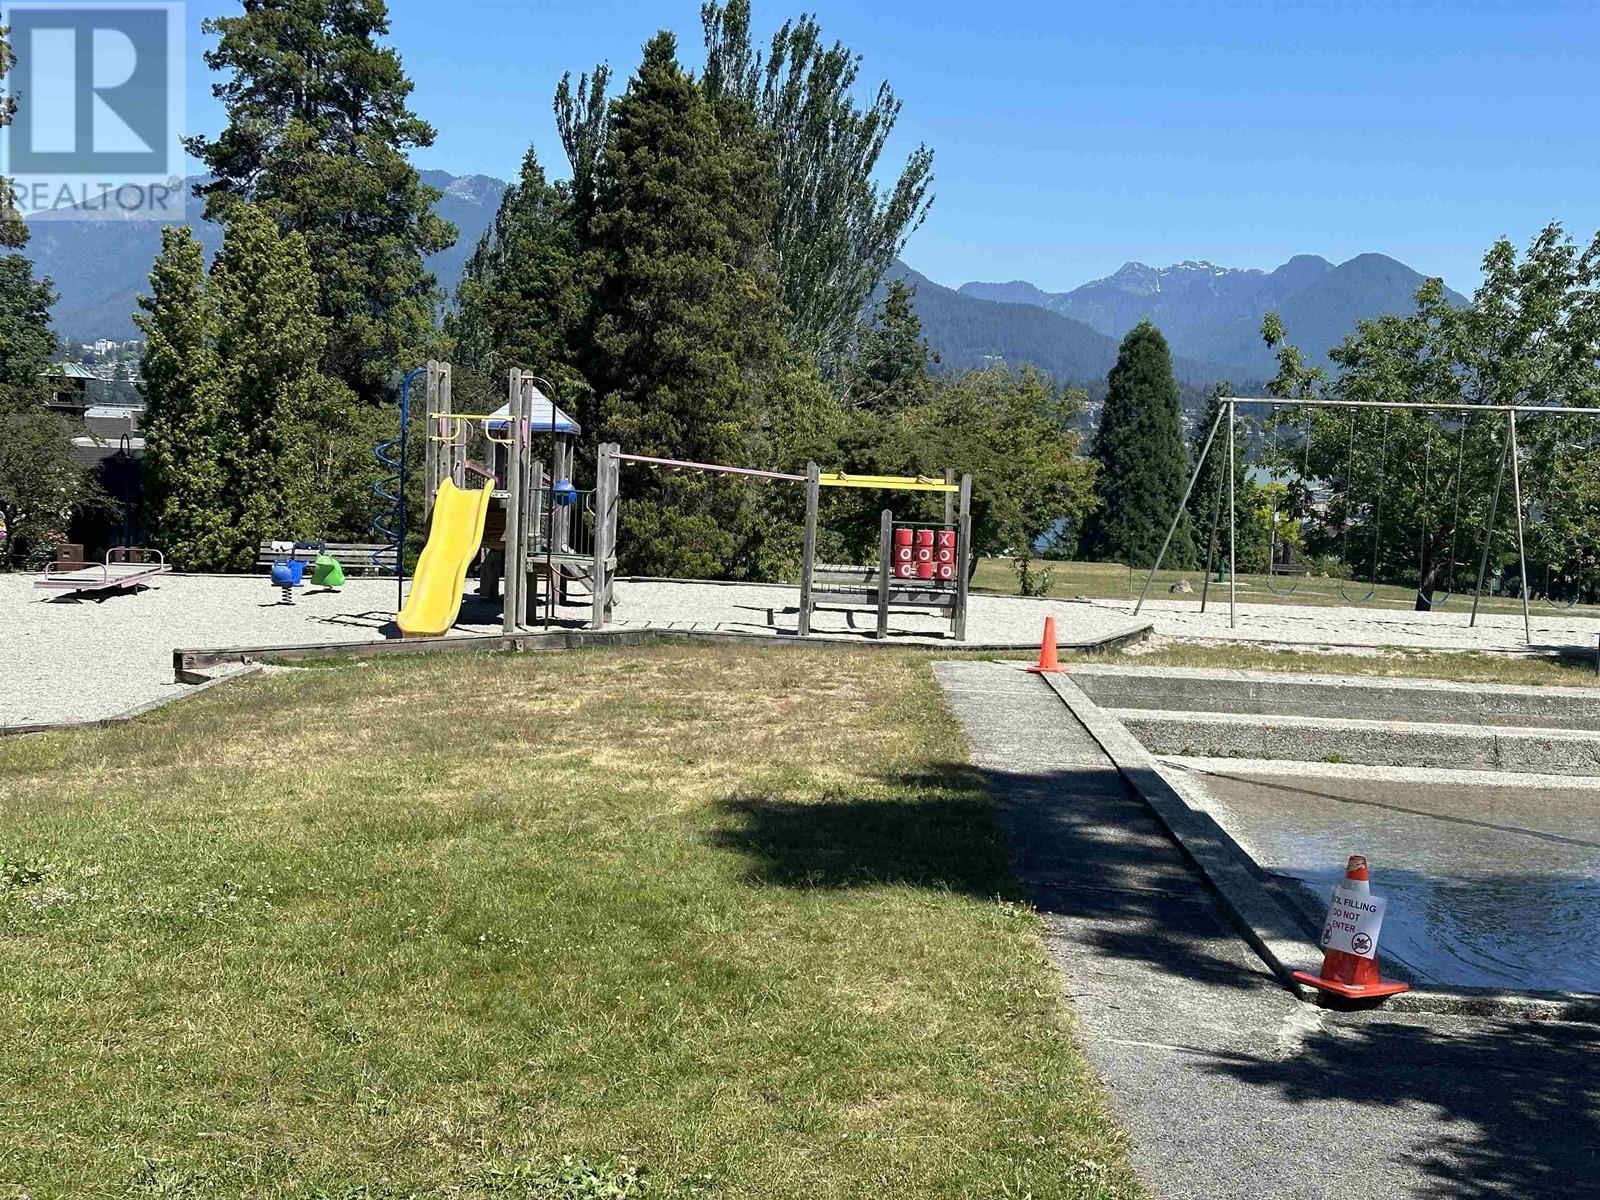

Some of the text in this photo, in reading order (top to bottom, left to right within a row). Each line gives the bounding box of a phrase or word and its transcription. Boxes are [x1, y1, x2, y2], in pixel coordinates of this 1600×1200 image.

[1343, 898, 1377, 913] FILLING
[1343, 910, 1360, 922] NOT
[1332, 919, 1356, 933] ENTER
